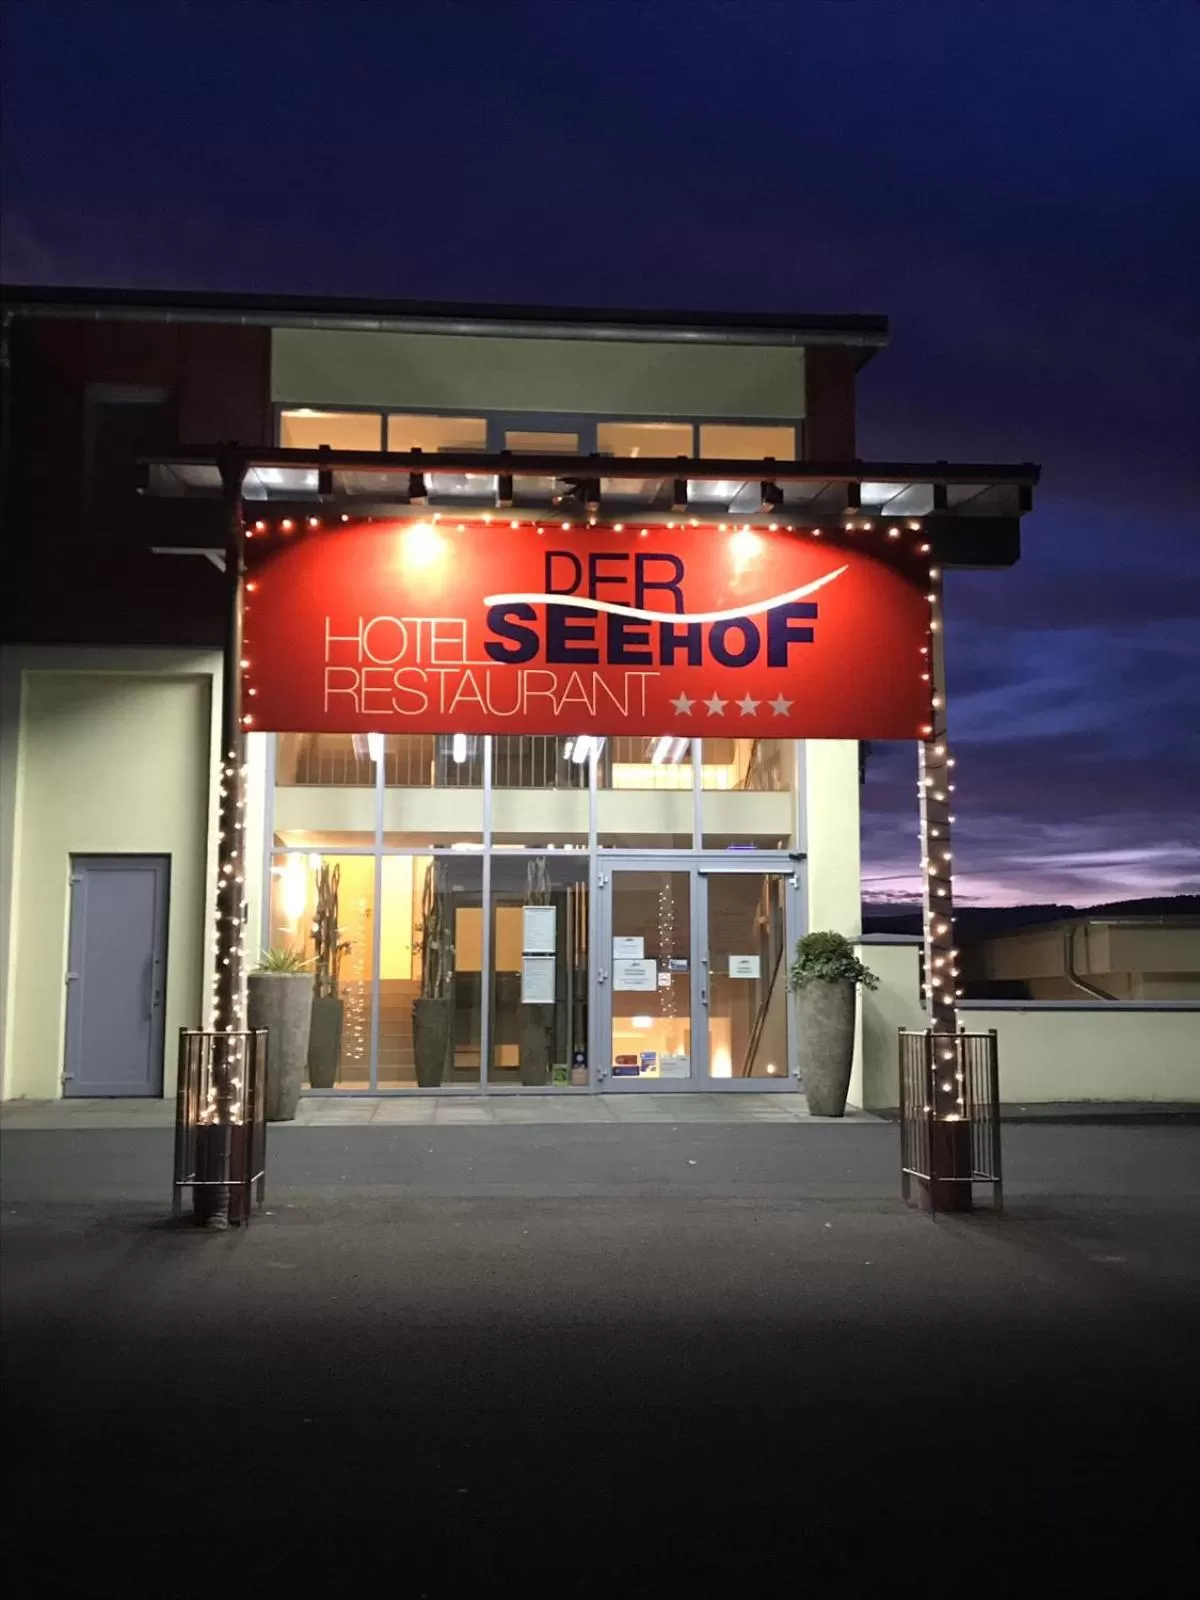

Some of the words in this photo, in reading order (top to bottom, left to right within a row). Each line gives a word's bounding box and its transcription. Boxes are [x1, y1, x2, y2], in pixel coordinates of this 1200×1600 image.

[545, 550, 684, 615] DER
[324, 616, 507, 665] HOTEL
[483, 602, 818, 668] SEEHOF
[324, 667, 661, 717] RESTAURANT
